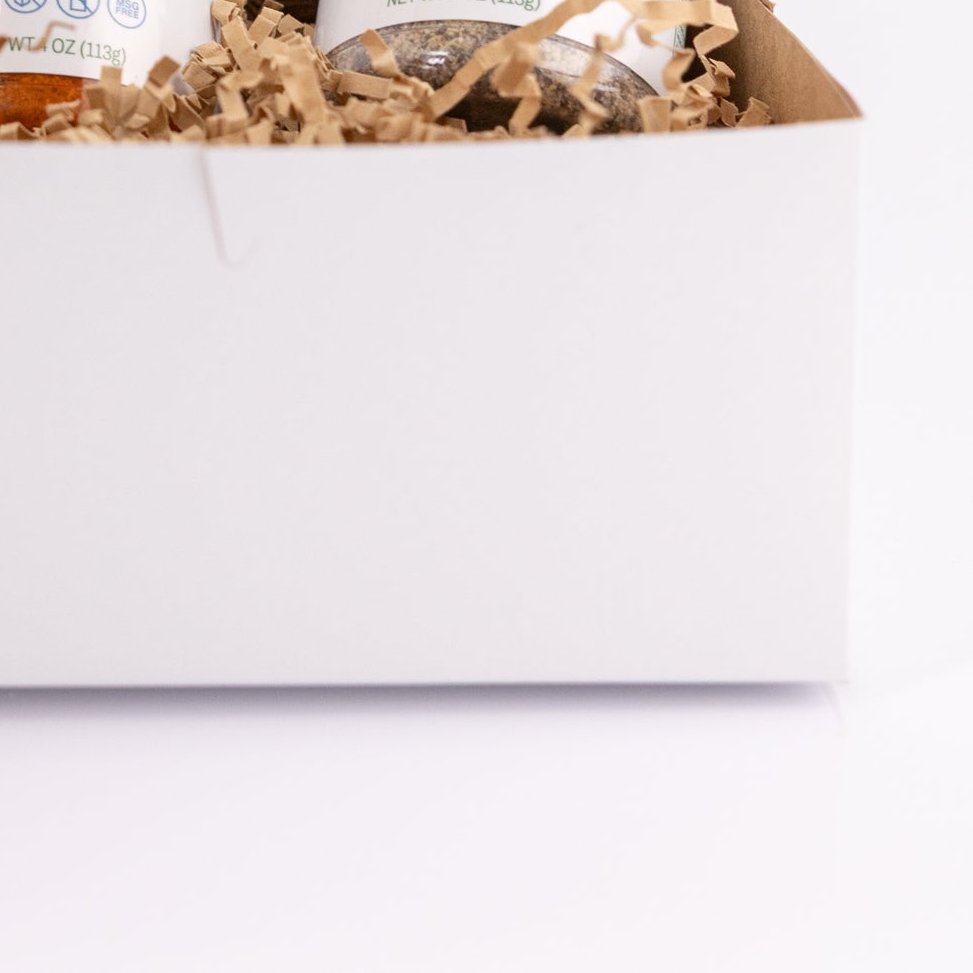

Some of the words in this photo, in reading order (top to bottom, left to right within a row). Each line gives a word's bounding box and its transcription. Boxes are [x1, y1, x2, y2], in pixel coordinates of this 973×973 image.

[115, 6, 139, 20] FREE
[8, 36, 36, 52] WT
[51, 38, 76, 55] OZ
[80, 40, 127, 67] (113g)
